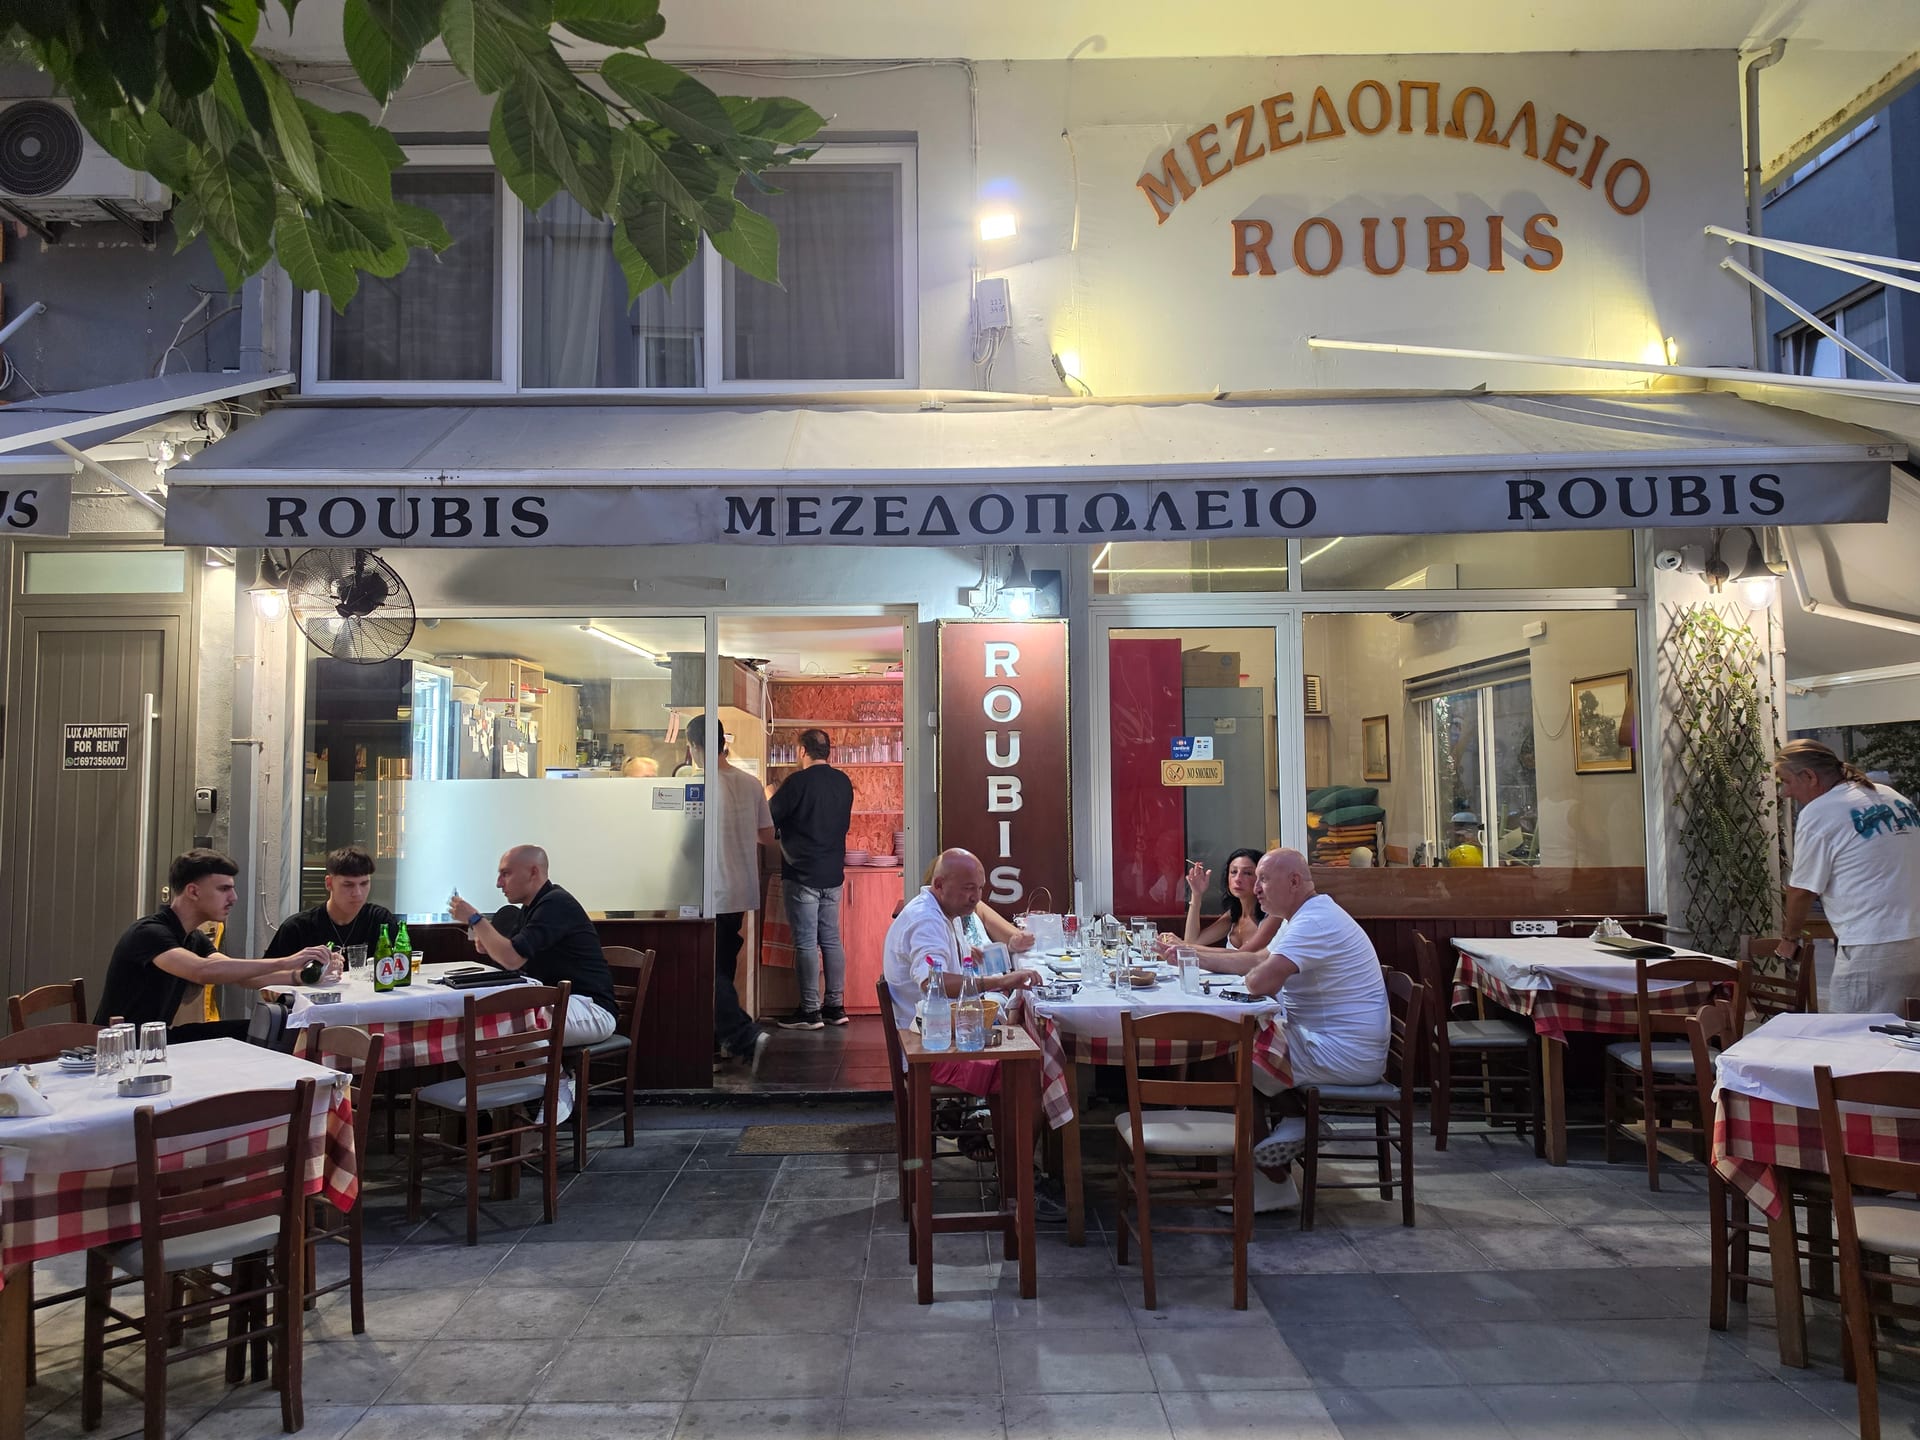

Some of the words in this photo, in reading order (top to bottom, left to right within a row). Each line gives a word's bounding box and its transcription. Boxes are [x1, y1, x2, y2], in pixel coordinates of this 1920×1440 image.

[1136, 79, 1651, 225] ΜΕΖΕΔΟΠΩΛΕΙΟ
[1230, 213, 1564, 276] ROUBIS
[264, 496, 550, 539] ROUBIS
[723, 486, 1317, 537] ΜΕΖΕΔΟΠΩΛΕΙΟ
[1506, 473, 1785, 521] ROUBIS
[66, 727, 82, 739] LUX
[82, 727, 128, 739] APARTMENT
[74, 740, 92, 753] FOR
[96, 740, 120, 753] RENT
[982, 641, 1024, 904] ROUBIS
[1187, 767, 1195, 779] NO
[1195, 767, 1219, 779] SMOKING
